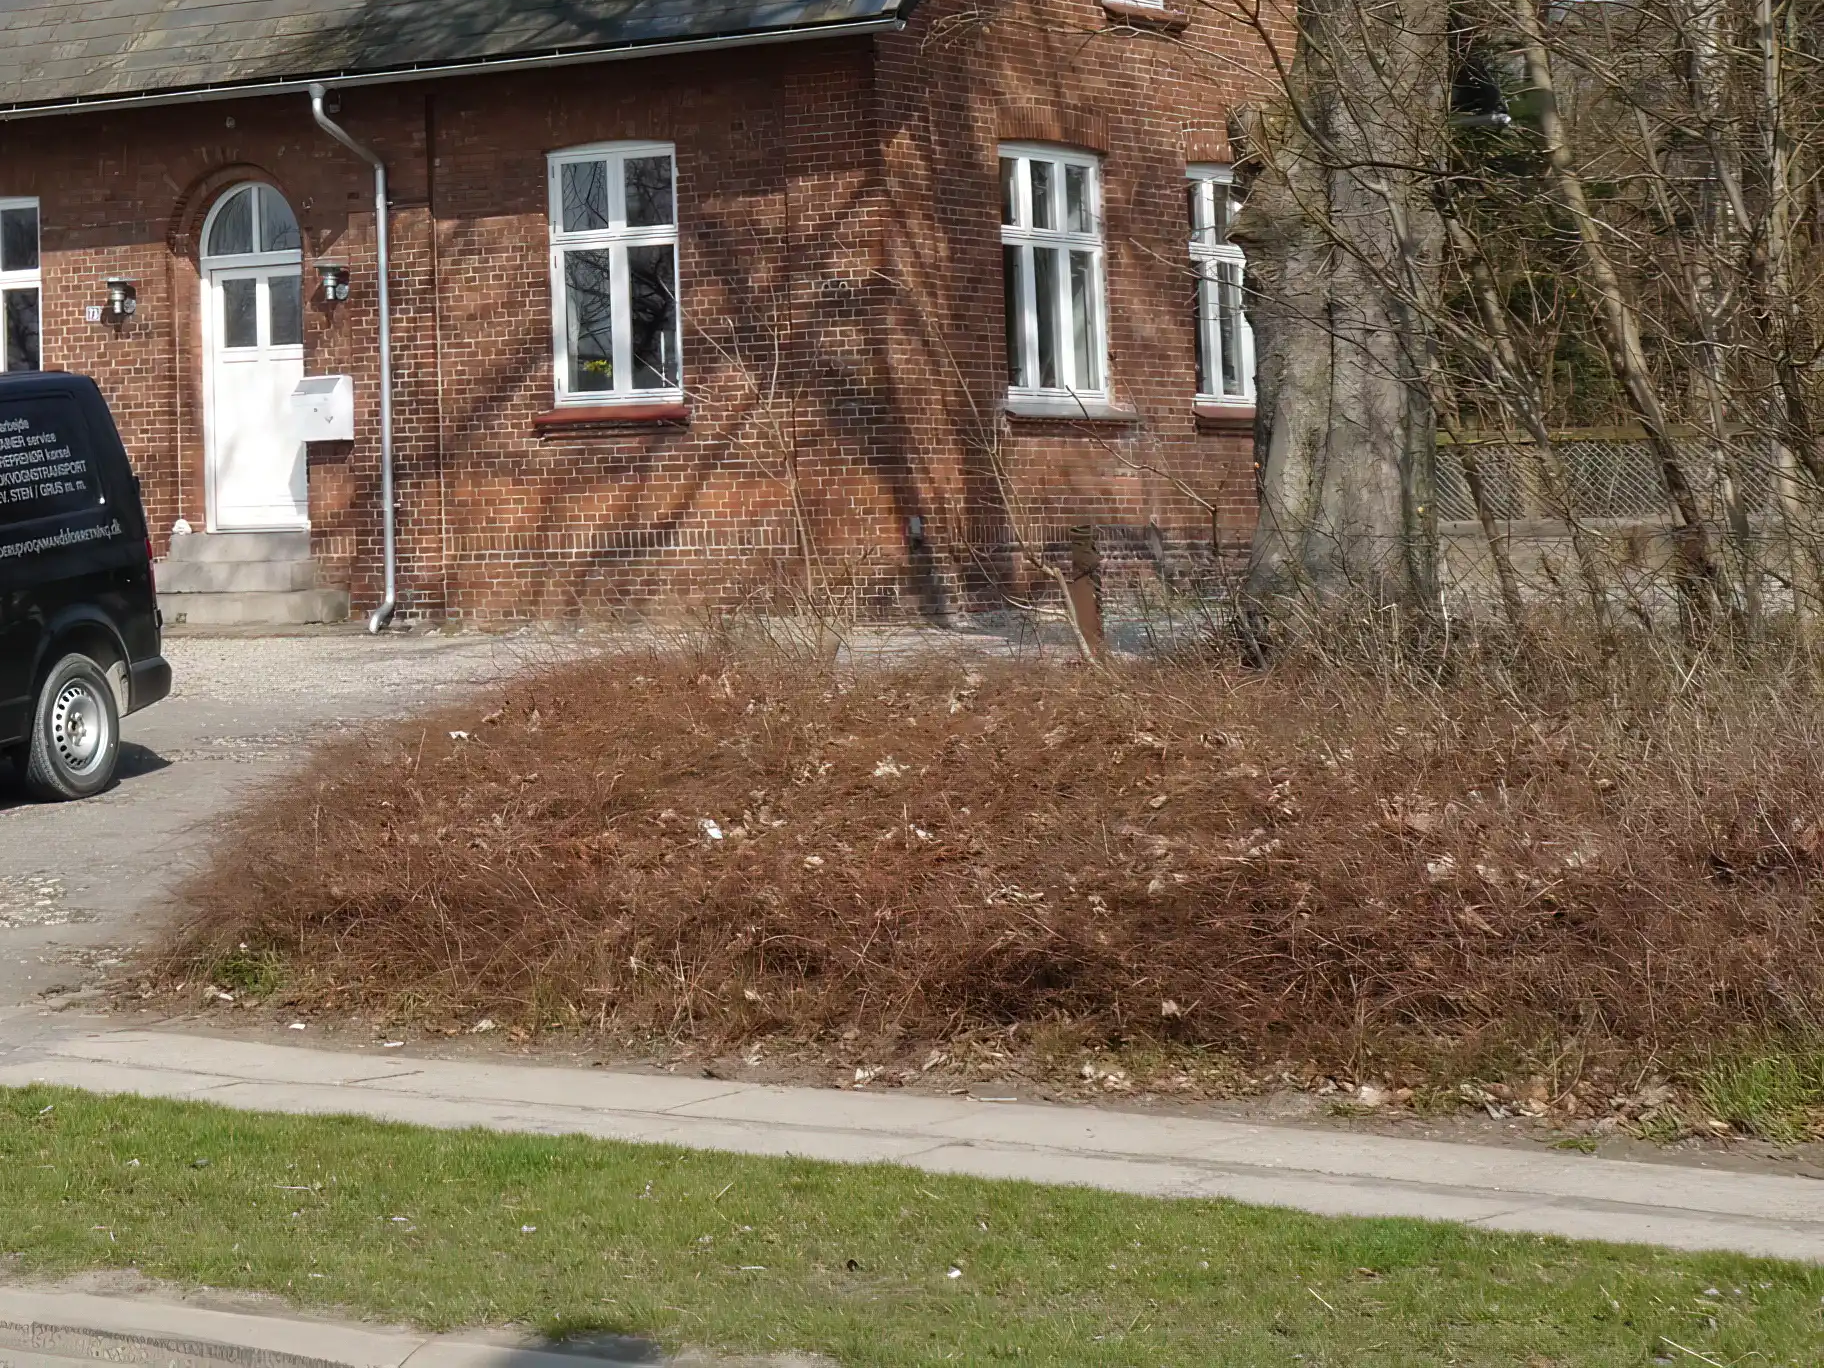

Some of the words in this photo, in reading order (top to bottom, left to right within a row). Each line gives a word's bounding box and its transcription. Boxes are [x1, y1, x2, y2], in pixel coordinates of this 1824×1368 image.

[26, 432, 57, 447] service
[11, 486, 34, 502] STEN
[39, 481, 64, 497] GRUS
